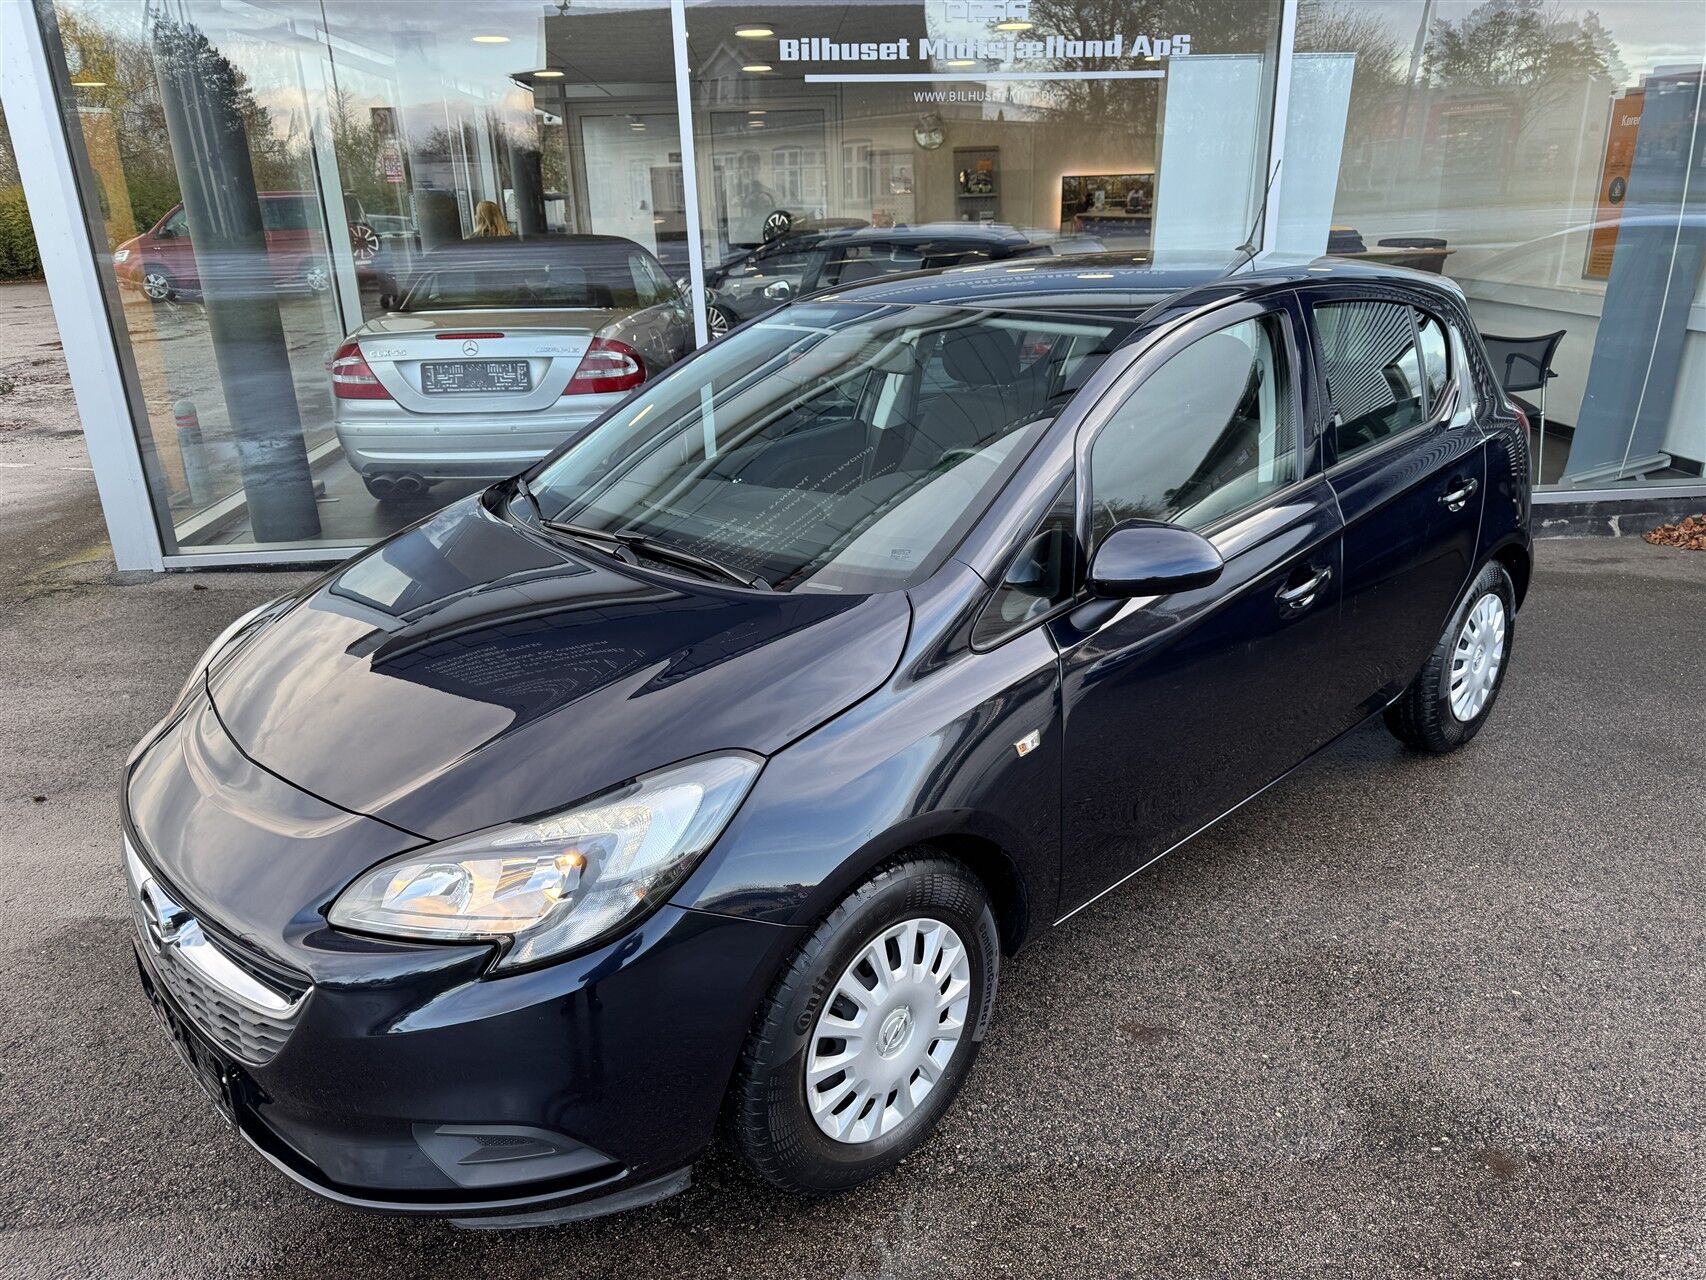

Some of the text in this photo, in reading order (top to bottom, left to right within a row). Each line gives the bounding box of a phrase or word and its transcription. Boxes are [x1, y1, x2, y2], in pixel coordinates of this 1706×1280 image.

[779, 34, 1191, 63] Bilhuset Midtsjælland ApS
